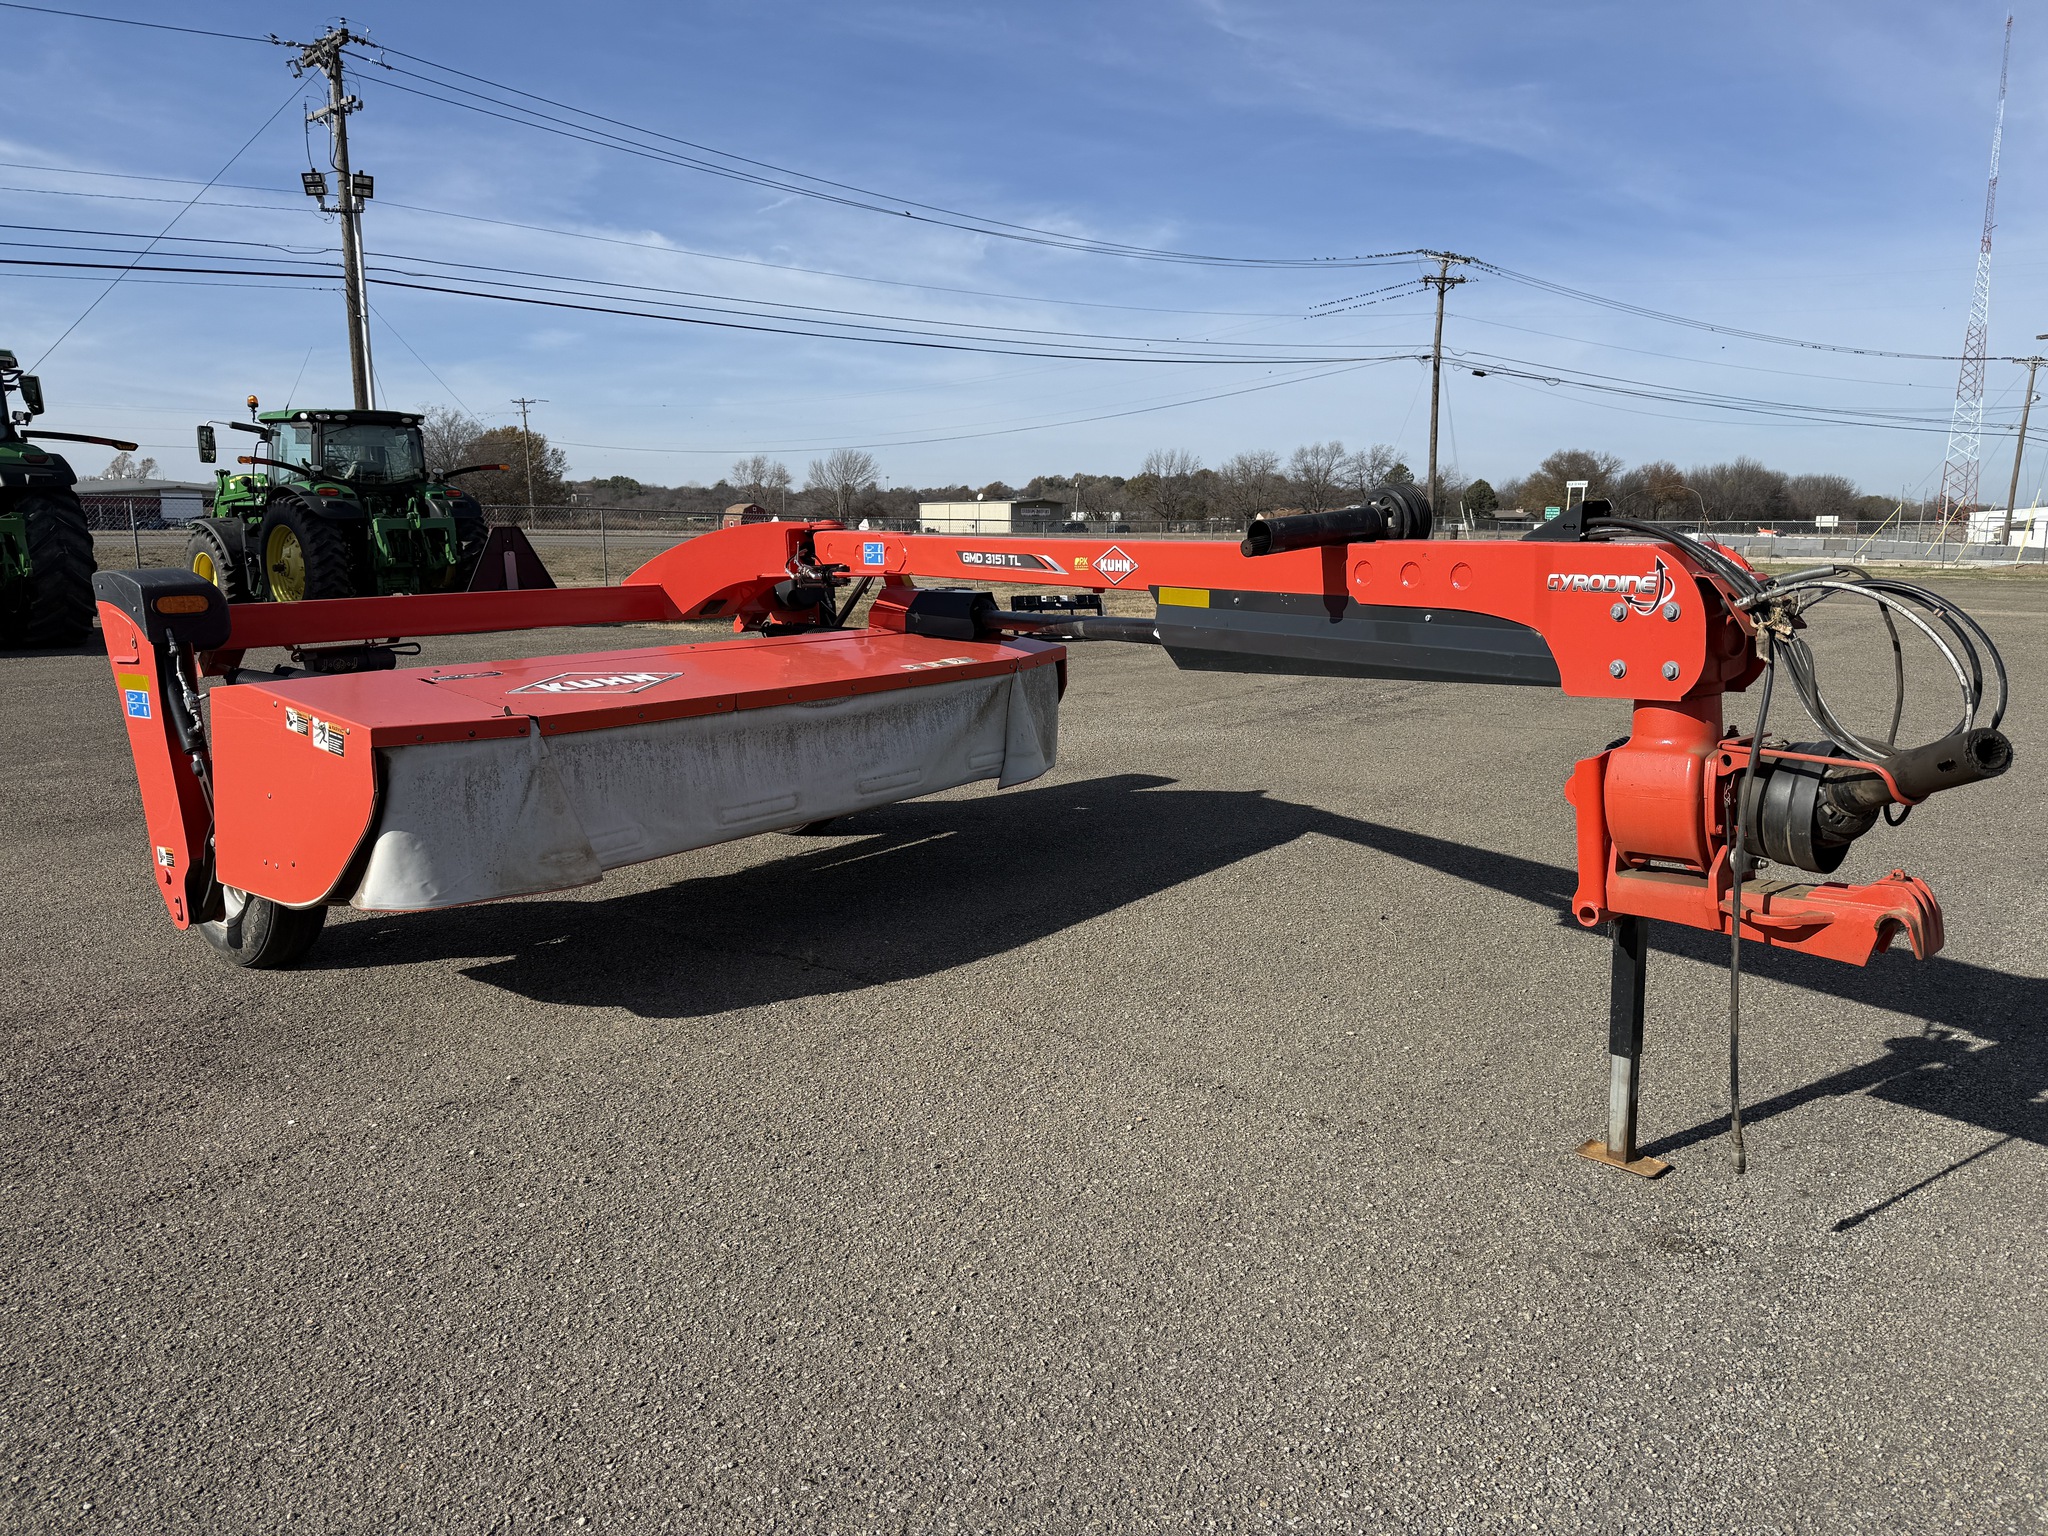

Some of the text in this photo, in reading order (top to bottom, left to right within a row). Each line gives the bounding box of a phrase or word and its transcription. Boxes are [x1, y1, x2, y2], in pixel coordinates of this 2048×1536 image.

[962, 552, 1022, 566] GMD 3151 TL
[1100, 558, 1130, 572] KUHN
[1547, 573, 1658, 594] GYRODINE
[535, 673, 661, 693] KUHN
